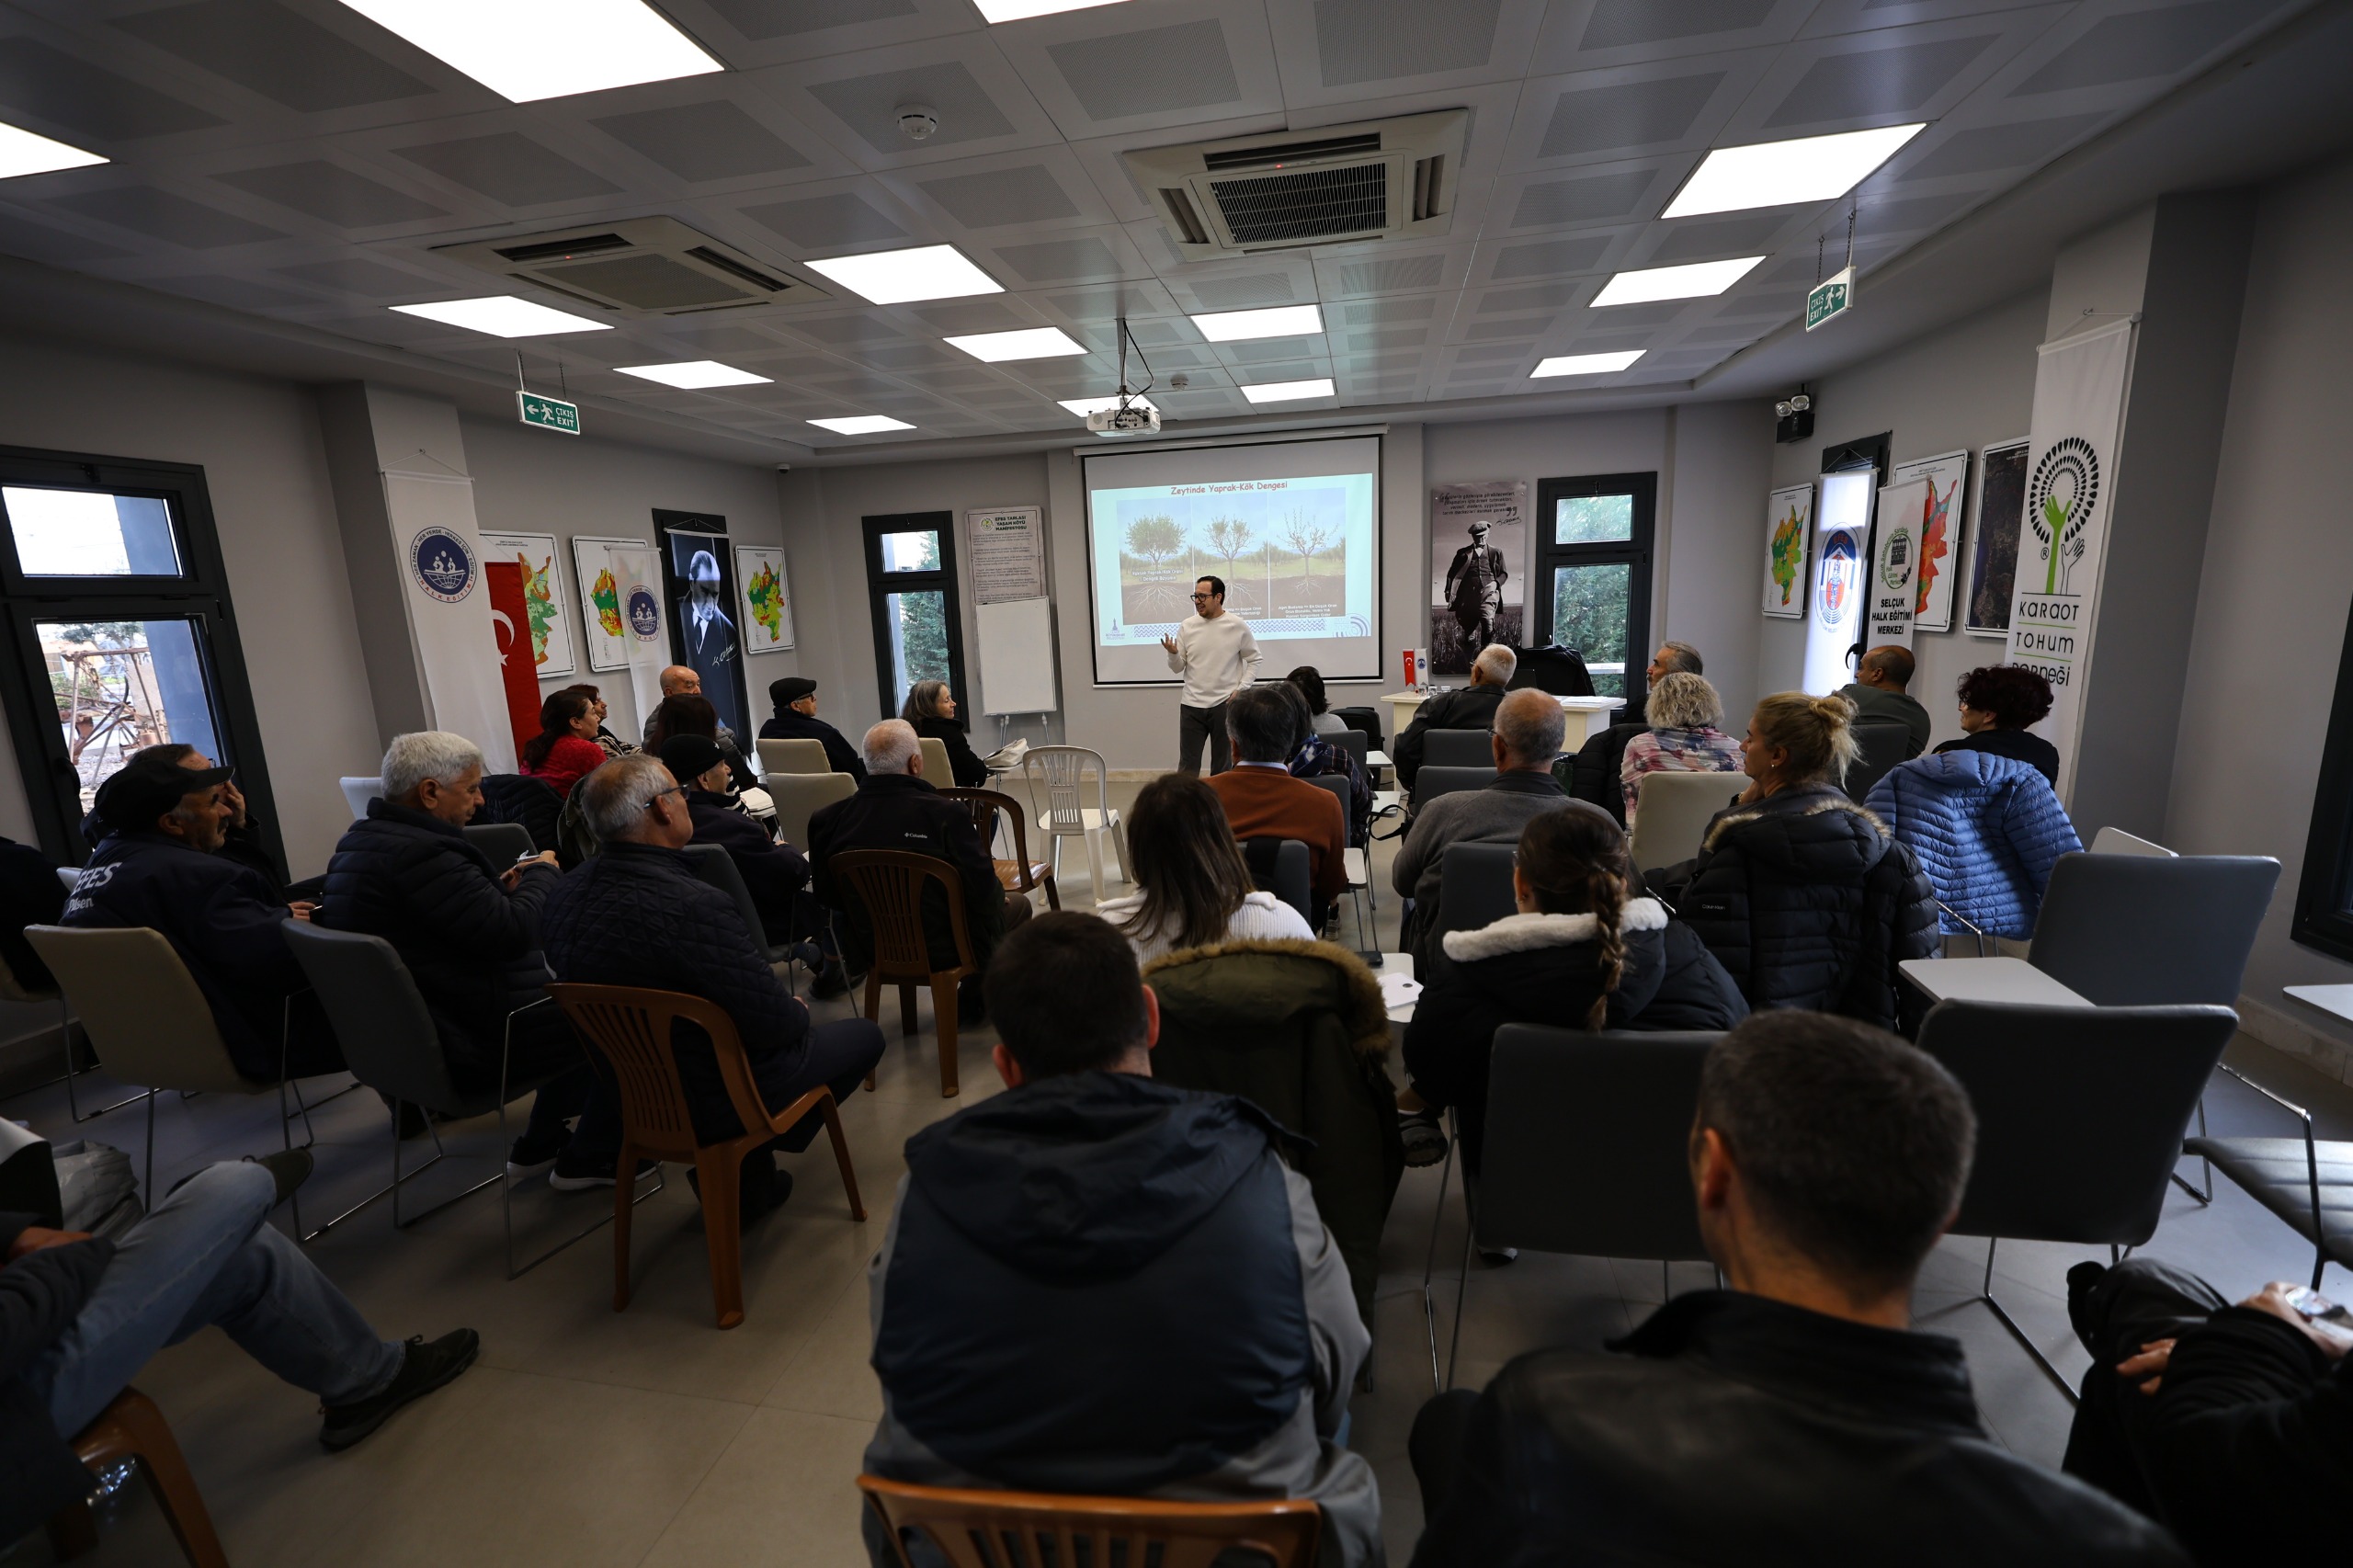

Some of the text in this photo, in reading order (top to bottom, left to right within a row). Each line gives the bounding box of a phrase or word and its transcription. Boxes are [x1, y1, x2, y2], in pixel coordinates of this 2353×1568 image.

[1810, 295, 1824, 311] ÇIKIŞ
[1810, 306, 1823, 322] EXIT
[555, 407, 574, 419] ÇIKIŞ
[557, 416, 574, 427] EXIT
[1170, 481, 1288, 496] Zeytinde Yaprak-Kök Dengesi
[1881, 597, 1905, 609] SELÇUK
[1871, 609, 1913, 622] HALK EĞİTİMİ
[1877, 623, 1904, 635] MERKEZİ
[71, 861, 122, 897] EFES
